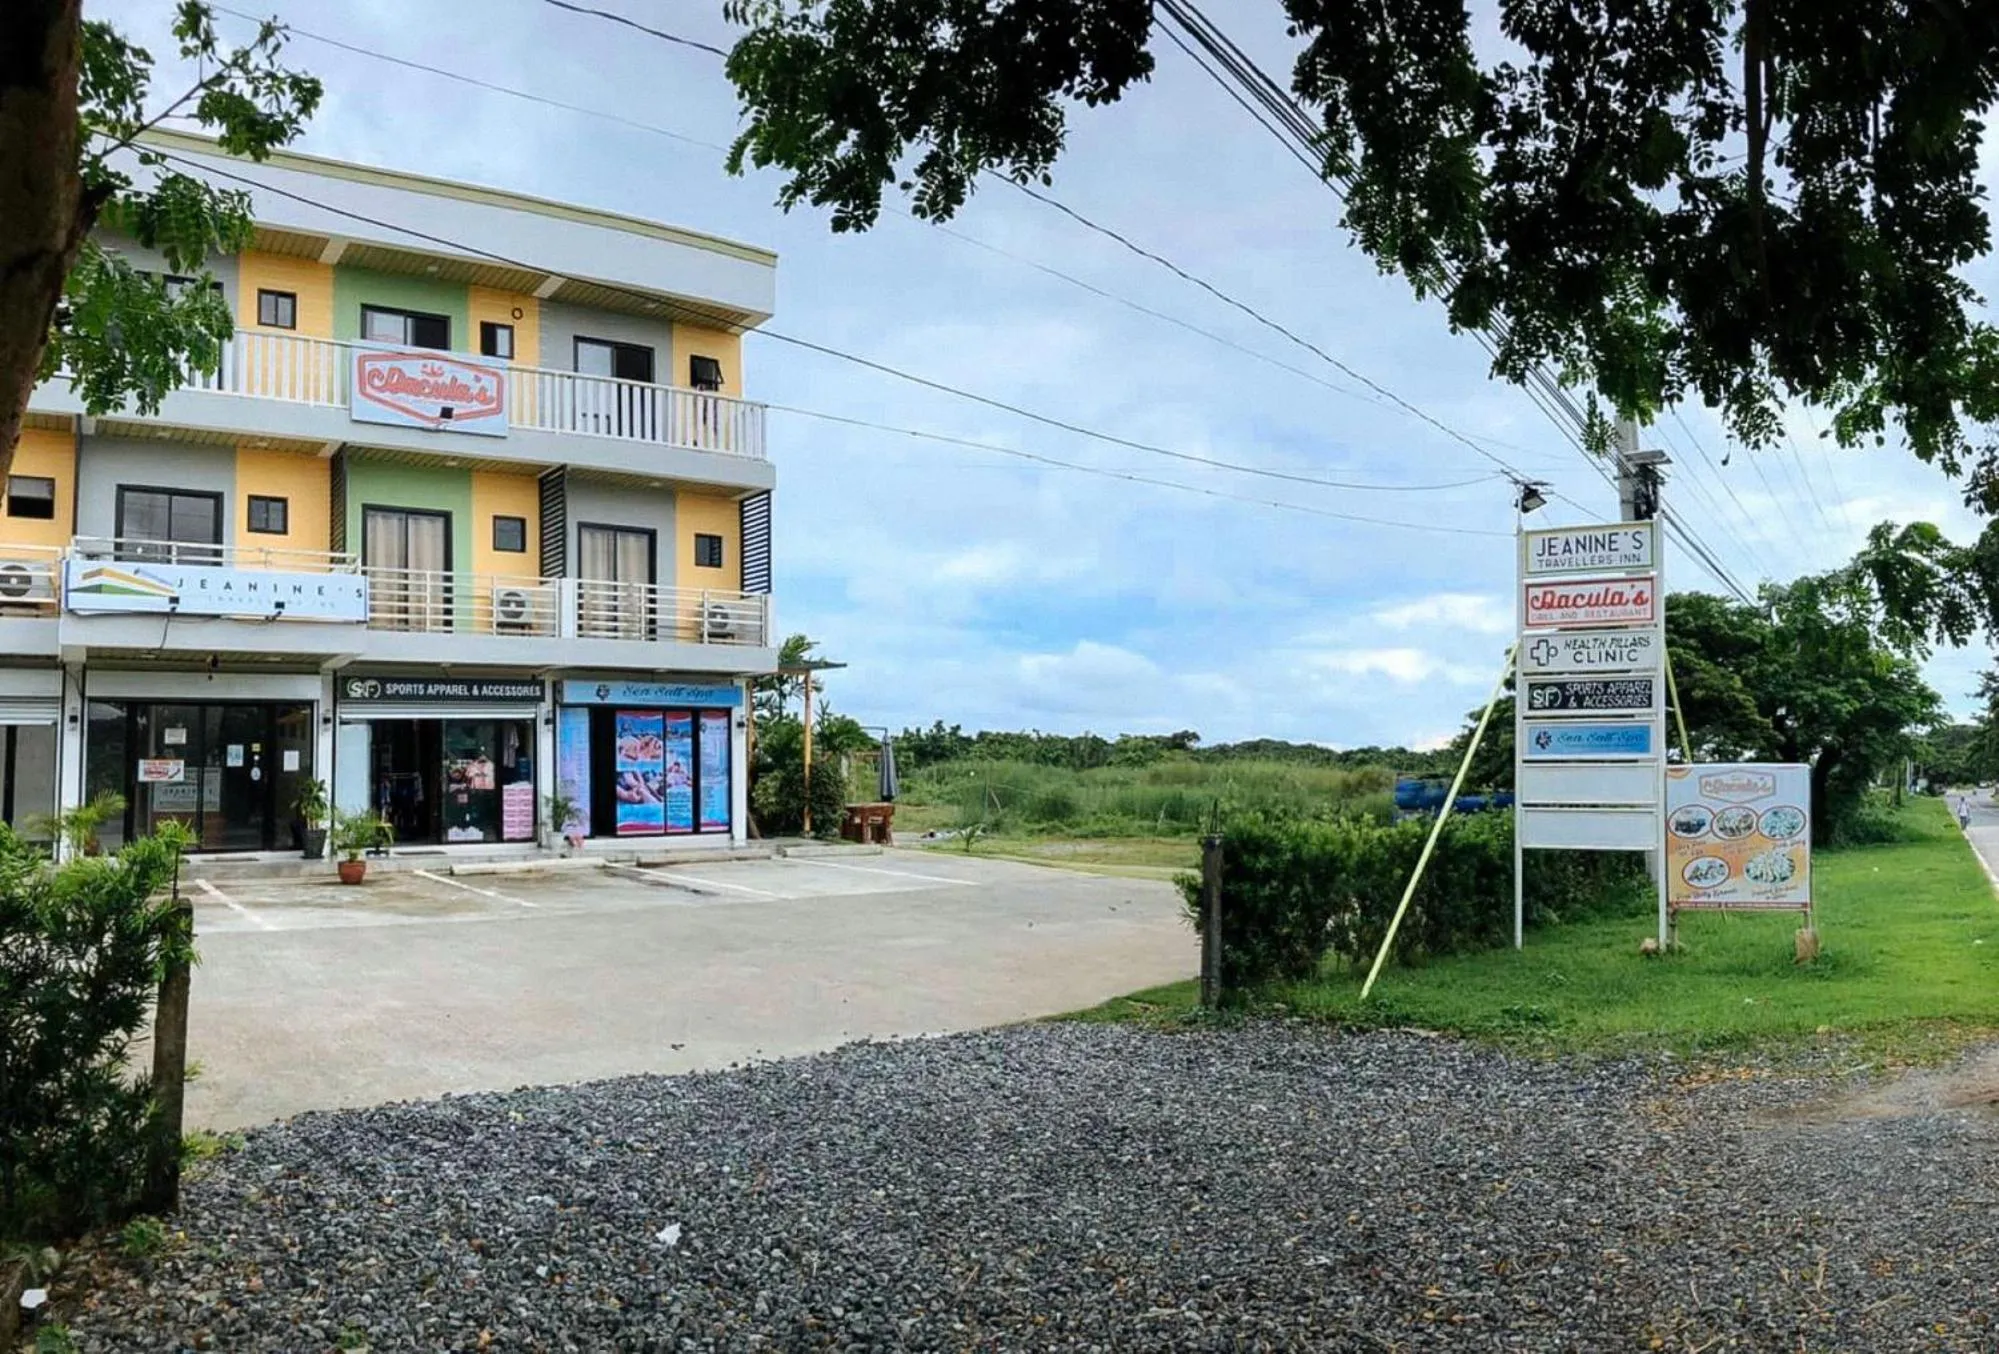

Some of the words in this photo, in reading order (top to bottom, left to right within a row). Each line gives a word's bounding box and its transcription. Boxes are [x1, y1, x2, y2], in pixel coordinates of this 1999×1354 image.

[367, 366, 494, 404] Dacula's
[1536, 530, 1644, 557] JEANINE'S
[1538, 555, 1613, 568] TRAVELLERS
[1619, 553, 1642, 564] INN
[1531, 584, 1649, 610] Dacula's
[1564, 638, 1606, 649] HEALTH
[1573, 649, 1639, 663] CLINIC
[386, 683, 424, 696] SPORTS
[427, 683, 469, 696] APPAREL
[472, 684, 479, 696] &
[1565, 682, 1604, 695] SPORTS
[1606, 680, 1652, 694] APPAREL
[1583, 695, 1649, 707] ACCESSORIES
